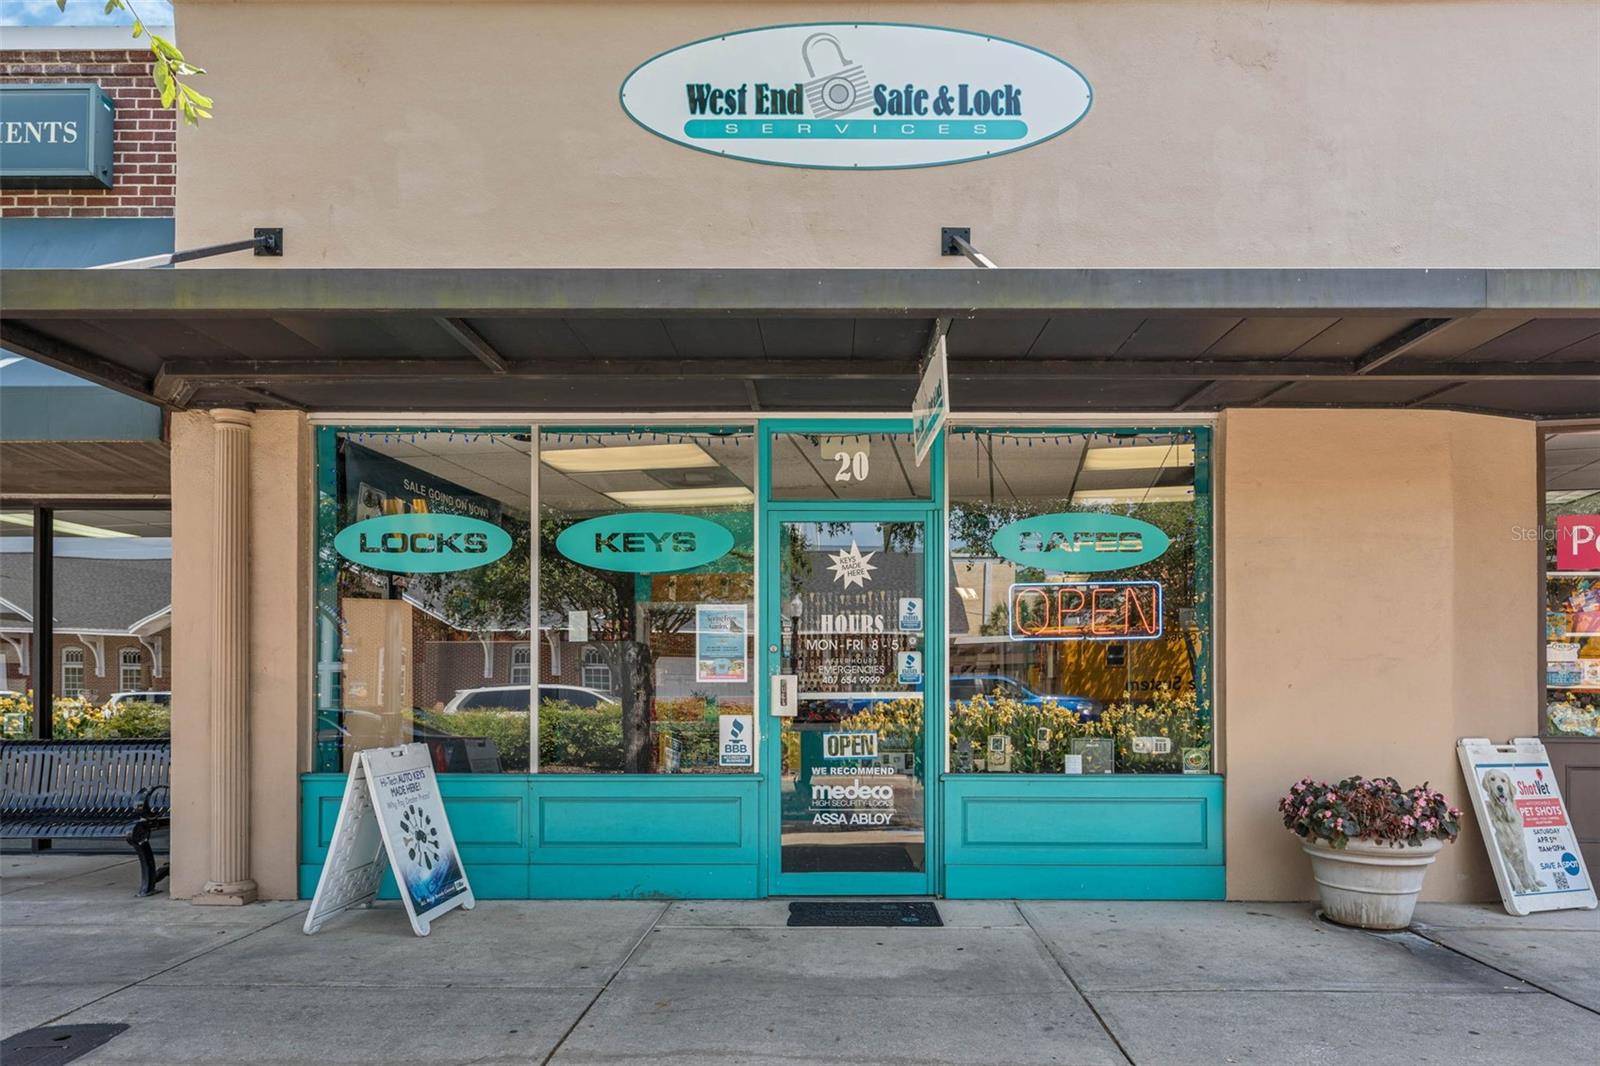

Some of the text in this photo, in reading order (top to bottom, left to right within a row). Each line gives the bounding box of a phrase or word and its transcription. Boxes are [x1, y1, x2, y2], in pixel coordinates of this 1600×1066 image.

[686, 83, 1022, 116] West End Safe & Lock
[725, 123, 987, 135] SERVICES
[834, 451, 869, 481] 20
[403, 479, 489, 518] SALE GOING ON NOW!
[359, 532, 488, 553] LOCKS
[594, 531, 696, 553] KEYS
[1019, 531, 1143, 553] SAFES
[840, 556, 856, 564] KEYS
[841, 562, 861, 571] MADE
[847, 569, 865, 577] HERE
[1015, 586, 1157, 635] OPEN
[820, 614, 884, 634] HOURS
[819, 665, 885, 674] EMERGENCIES
[822, 676, 881, 684] 407 654 9999
[725, 744, 747, 753] BBB
[827, 735, 874, 756] OPEN
[398, 771, 413, 783] AUTO
[413, 769, 426, 780] KEYS
[812, 767, 894, 775] WE RECOMMEND
[391, 784, 407, 797] MADE
[812, 779, 893, 799] medeco
[1517, 780, 1551, 795] ShotVet
[1519, 805, 1562, 816] PET SHOTS
[812, 813, 893, 825] ASSA ABLOY
[1540, 862, 1556, 870] SAVE
